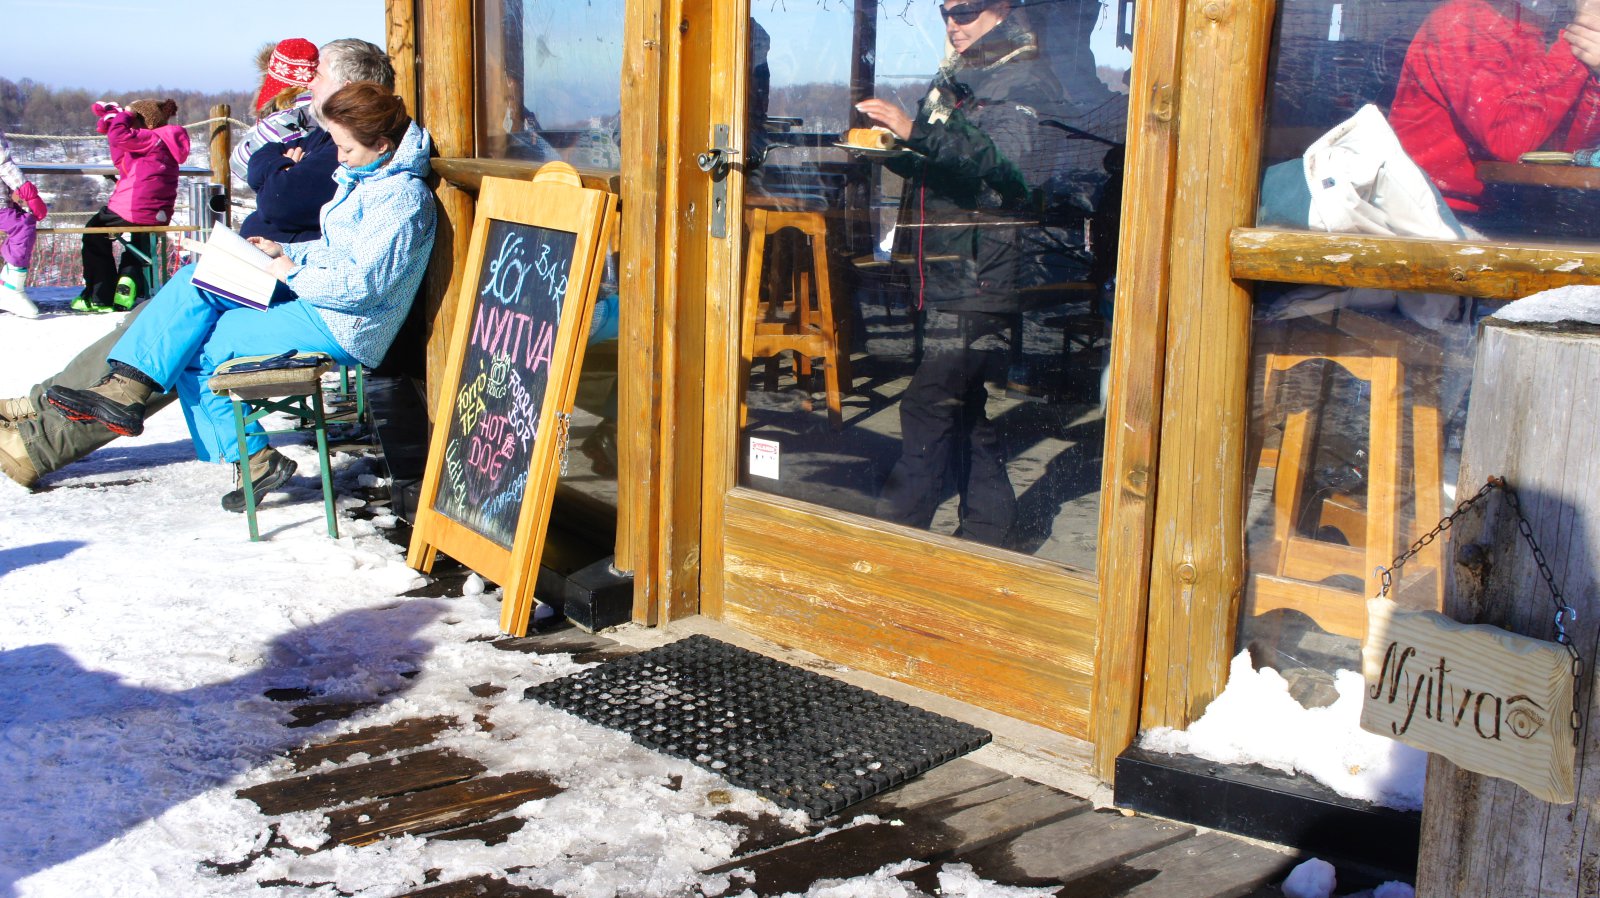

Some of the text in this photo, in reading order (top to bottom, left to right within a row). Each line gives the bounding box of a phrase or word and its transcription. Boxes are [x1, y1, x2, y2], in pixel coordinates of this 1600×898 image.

[471, 303, 553, 378] NYITVA
[459, 396, 486, 436] TEA
[480, 414, 508, 445] HOT
[508, 402, 531, 453] BOR
[468, 436, 502, 480] DOG
[1370, 641, 1502, 741] Nyitva
